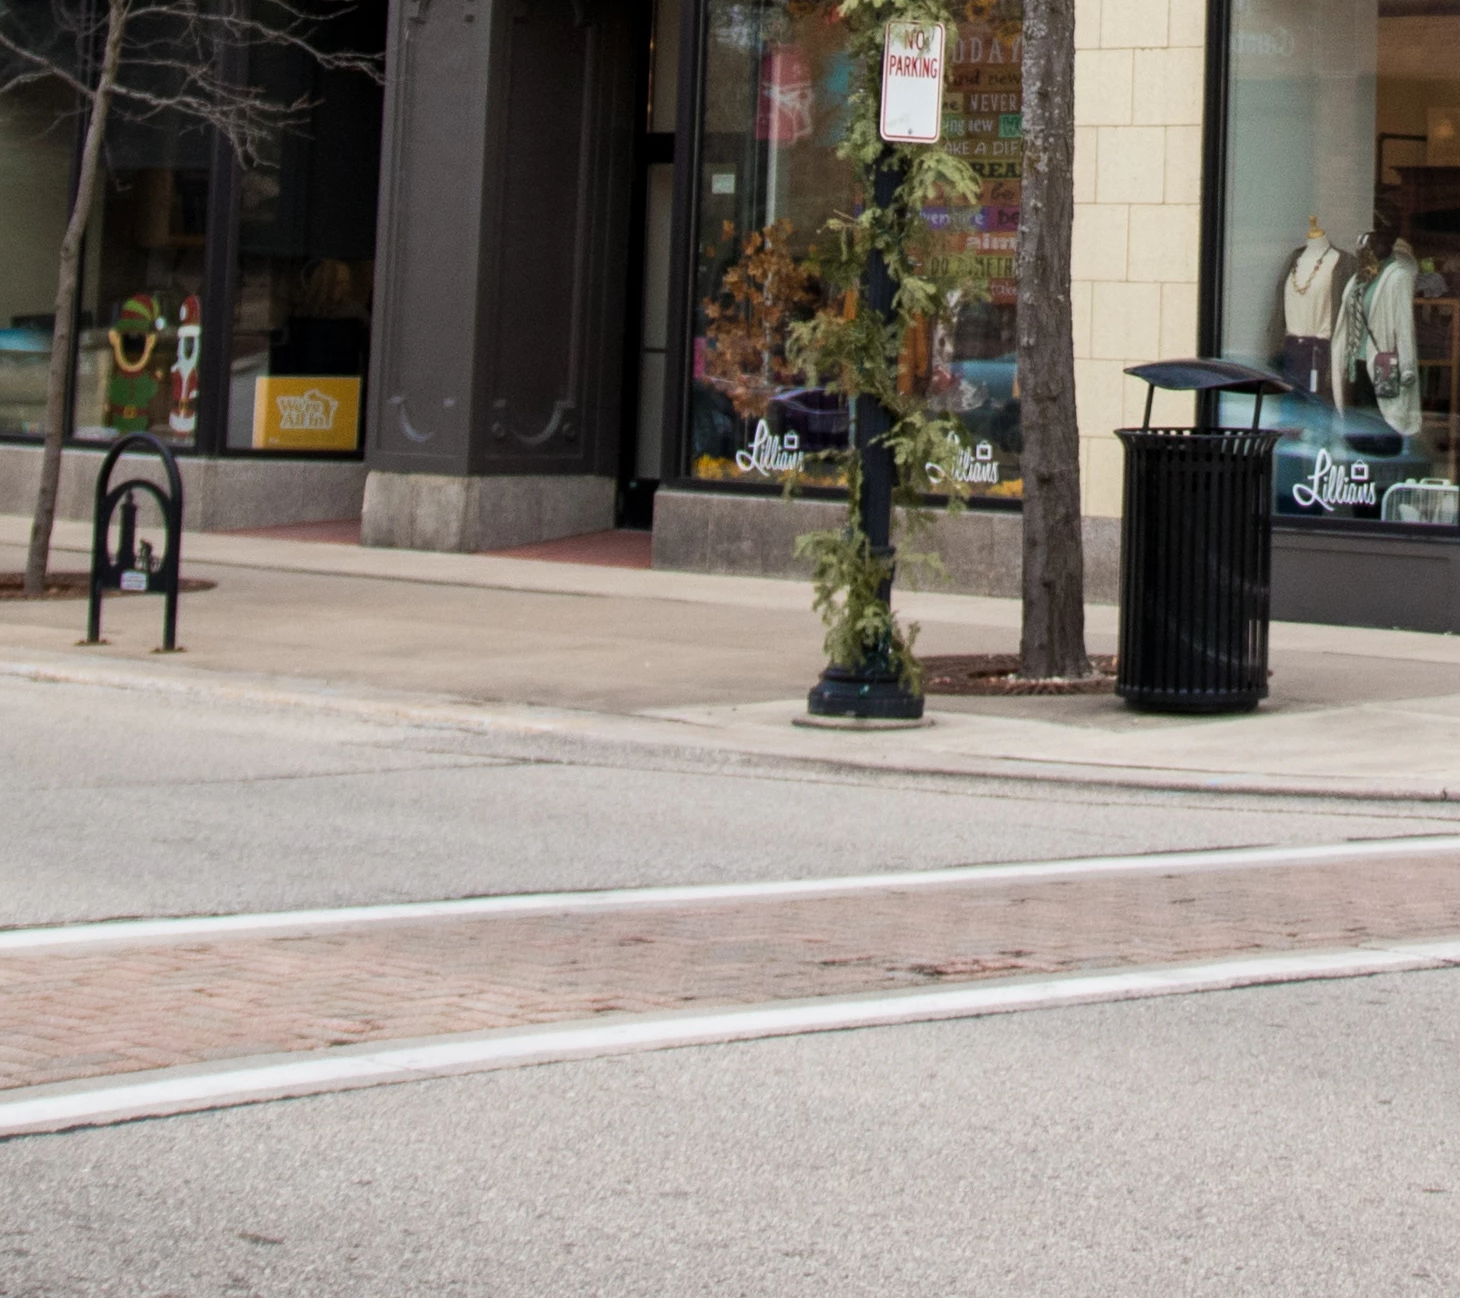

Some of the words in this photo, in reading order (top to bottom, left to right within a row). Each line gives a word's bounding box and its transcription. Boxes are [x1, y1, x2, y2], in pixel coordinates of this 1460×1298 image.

[904, 29, 925, 51] NO
[889, 54, 938, 79] PARKING
[970, 93, 1018, 112] NEVER
[946, 141, 969, 156] AKE
[735, 418, 804, 477] Lillians
[1292, 448, 1377, 512] Lillians
